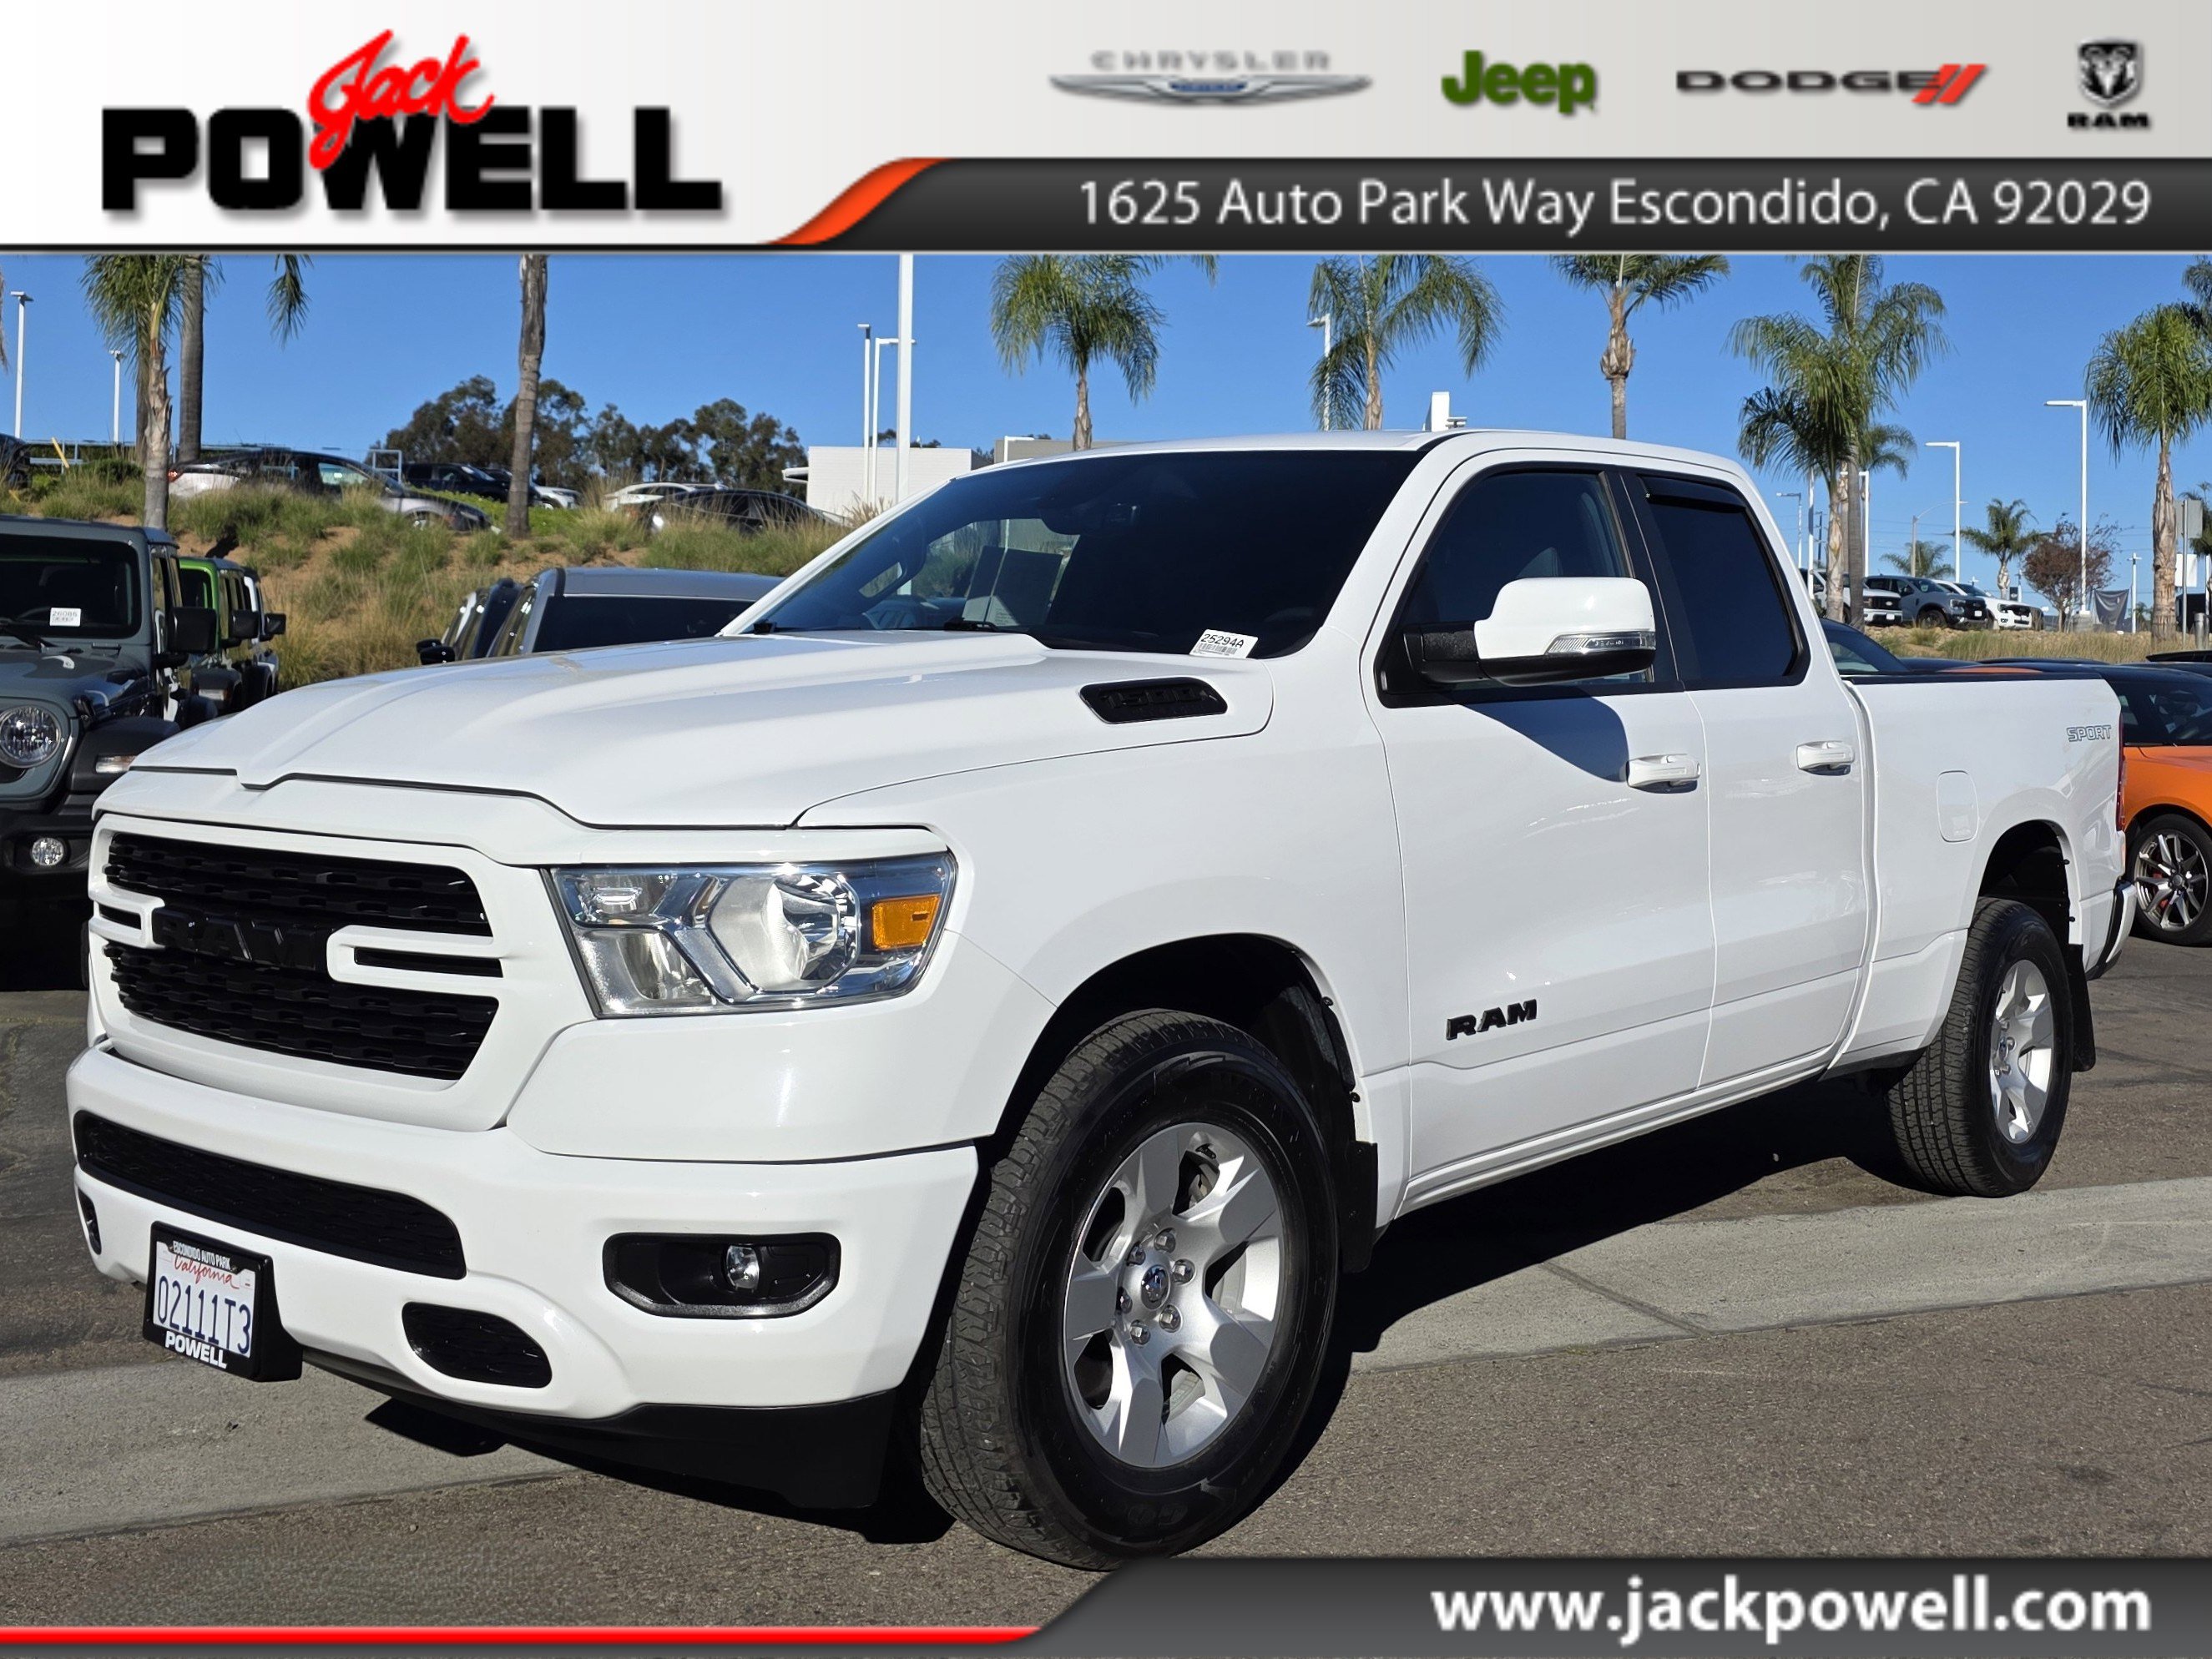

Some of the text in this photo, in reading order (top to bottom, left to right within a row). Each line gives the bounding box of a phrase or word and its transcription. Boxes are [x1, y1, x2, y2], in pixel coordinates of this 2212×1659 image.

[1200, 634, 1245, 648] 25294A
[2066, 724, 2112, 743] SPORT
[1446, 998, 1538, 1041] RAM
[174, 1253, 240, 1289] California
[201, 1250, 215, 1266] AUTO
[215, 1254, 231, 1270] PARK
[158, 1275, 251, 1354] 02111T3
[164, 1330, 228, 1369] POWELL
